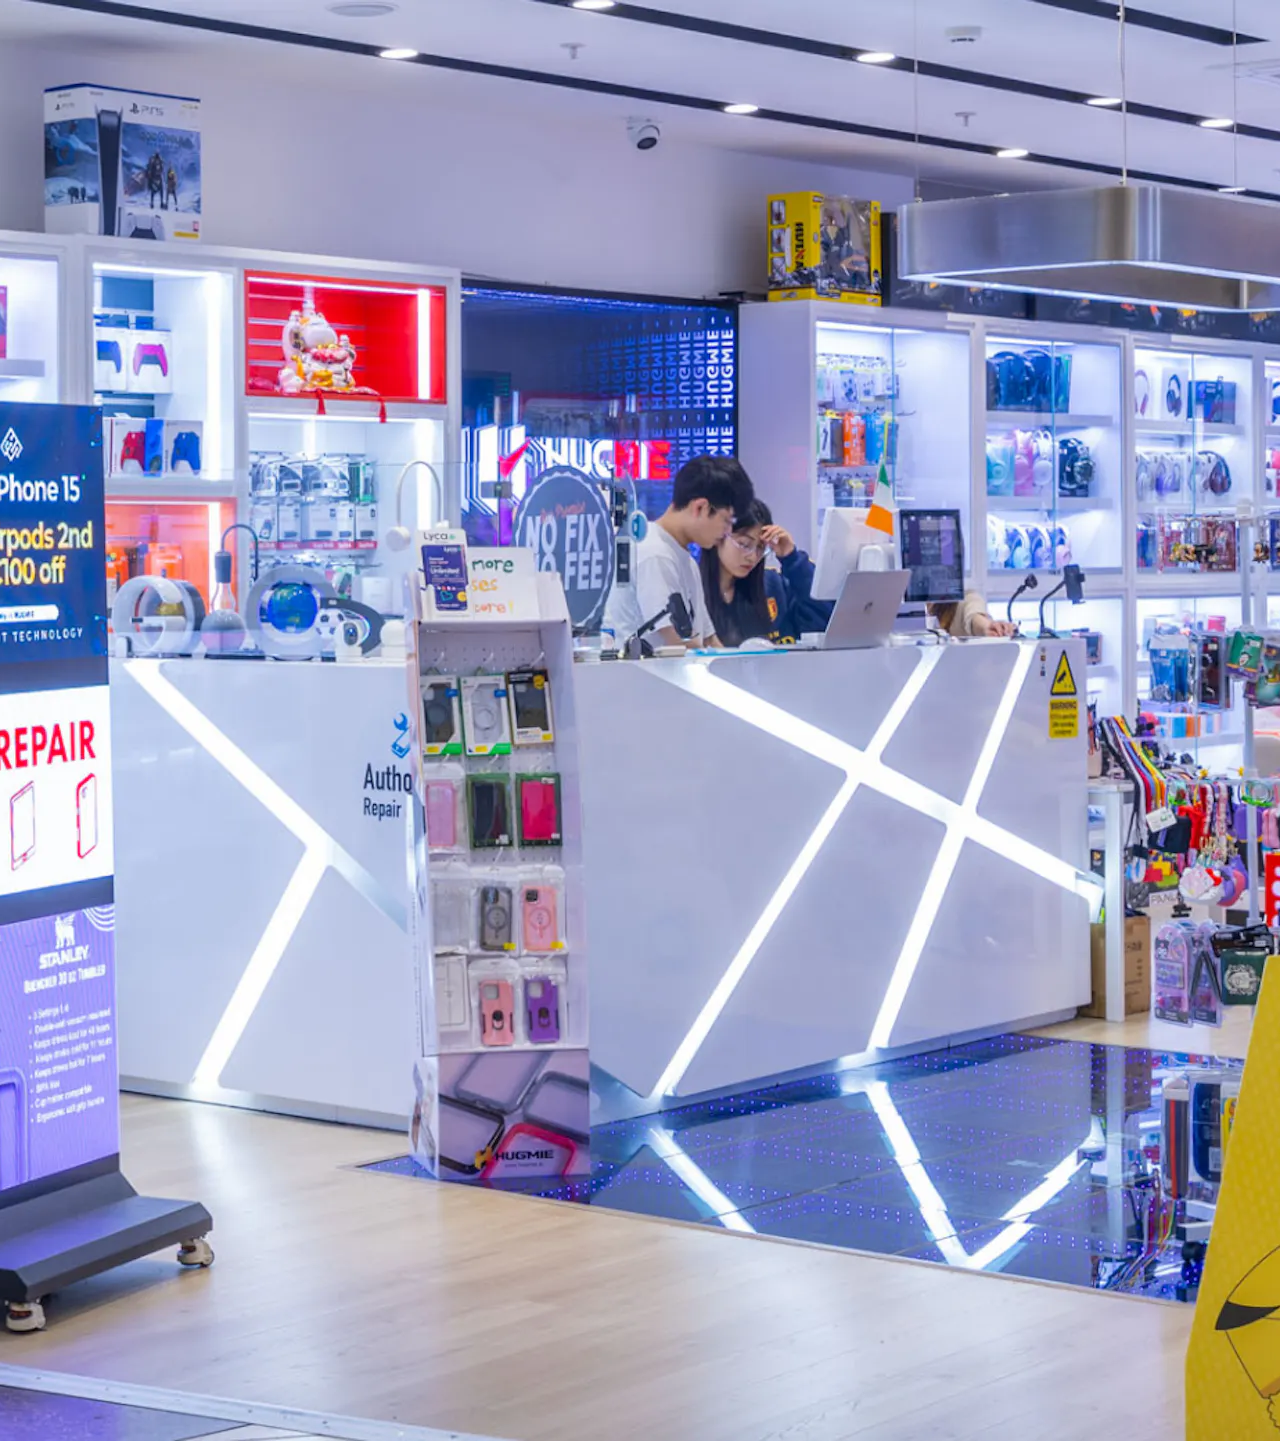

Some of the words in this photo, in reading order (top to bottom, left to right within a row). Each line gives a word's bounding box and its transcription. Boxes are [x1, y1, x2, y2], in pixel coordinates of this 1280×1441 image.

[693, 330, 705, 408] HUGMIE
[721, 328, 734, 408] HUGMIE
[61, 475, 81, 501] 15
[57, 520, 93, 550] 2nd
[423, 532, 448, 541] Lyca
[525, 514, 558, 555] NO
[564, 513, 601, 553] FIX
[39, 555, 66, 584] off
[472, 559, 514, 573] more
[564, 550, 603, 591] FEE
[471, 578, 498, 592] ses
[12, 627, 83, 643] TECHNOLOGY
[363, 762, 412, 792] Autho
[363, 797, 402, 821] Repair
[39, 945, 89, 970] STANLEY
[495, 1149, 554, 1161] HUGMIE
